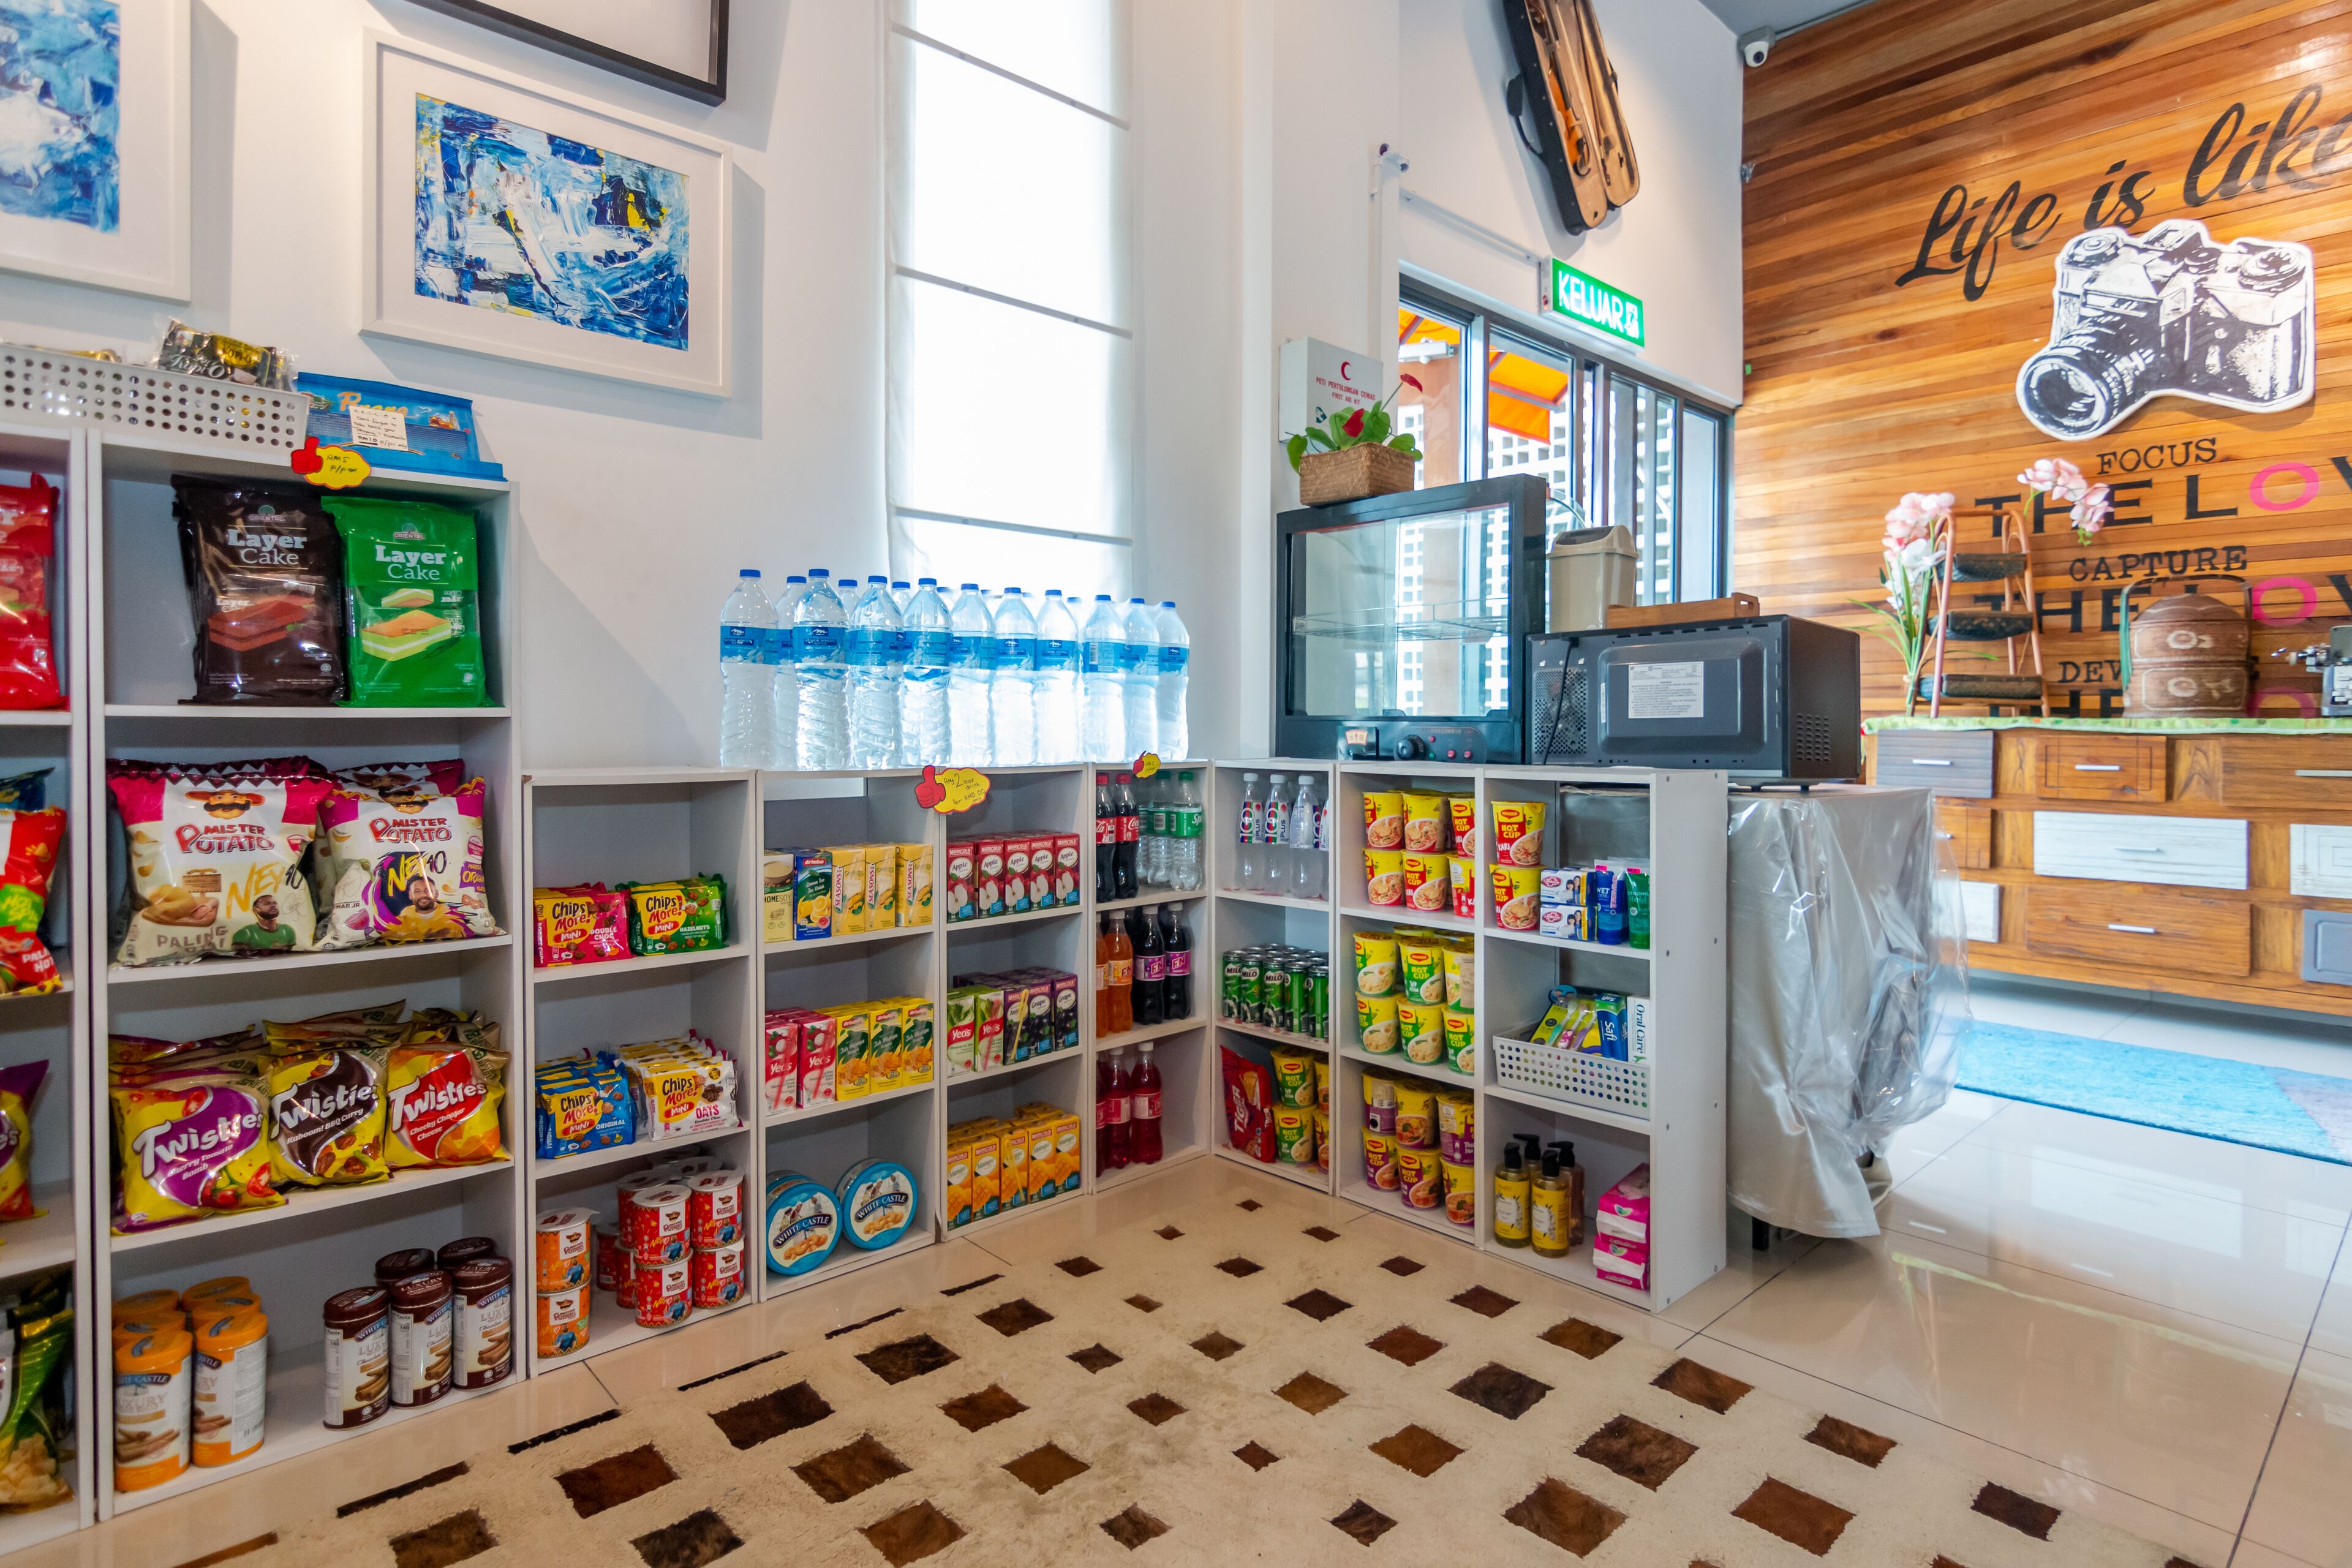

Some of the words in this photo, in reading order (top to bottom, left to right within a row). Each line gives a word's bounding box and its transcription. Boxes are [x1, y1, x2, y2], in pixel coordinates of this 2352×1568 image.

[1894, 180, 2062, 301] Life
[2084, 159, 2156, 231] is
[1558, 270, 1624, 333] KELUAR
[1316, 377, 1326, 386] PETI
[1360, 391, 1376, 401] CEMAS
[1332, 392, 1343, 401] FIRST
[2095, 437, 2218, 475] FOCUS
[227, 529, 307, 552] Layer
[240, 548, 299, 565] Cake
[375, 545, 447, 567] Layer
[2068, 545, 2248, 582] CAPTURE
[388, 564, 440, 581] Cake
[954, 773, 963, 788] 2
[203, 824, 265, 835] MISTER
[368, 818, 452, 844] POTATO
[392, 818, 447, 827] MISTER
[174, 824, 275, 854] POTATO
[983, 859, 998, 869] Apple
[1009, 856, 1025, 866] Apple
[1034, 853, 1049, 864] Apple
[1060, 851, 1074, 861] Apple
[952, 861, 968, 872] Apple
[552, 902, 586, 919] Chips
[646, 895, 677, 913] Chips
[561, 930, 581, 941] MINI
[590, 926, 617, 935] DOUBLE
[655, 922, 674, 933] MINI
[157, 925, 228, 948] PALING
[1031, 998, 1046, 1009] Grape
[1058, 992, 1072, 1002] Grape
[1635, 1004, 1646, 1027] Oral
[952, 1028, 971, 1039] Yeo's
[1635, 1029, 1646, 1054] Care
[662, 1077, 693, 1096] Chips
[389, 1076, 489, 1133] Twisties
[560, 1094, 590, 1112] Chips
[671, 1104, 689, 1116] MINI
[696, 1104, 720, 1119] OATS
[1232, 1085, 1245, 1133] TIGER
[286, 1125, 324, 1145] Kaboom!
[325, 1118, 342, 1131] BBQ
[341, 1107, 364, 1125] Curry
[410, 1120, 437, 1136] Cheeky
[568, 1122, 589, 1134] MINI
[595, 1119, 625, 1129] ORIGINAL
[417, 1126, 443, 1142] Cheese
[132, 1112, 264, 1178] Twisties
[167, 1155, 200, 1177] Cherry
[200, 1144, 233, 1161] Tomato
[1368, 1152, 1383, 1161] HOT
[182, 1163, 209, 1181] Bomb
[858, 1200, 880, 1219] WHITE
[881, 1193, 907, 1205] CASTLE
[776, 1223, 801, 1245] WHITE
[802, 1215, 830, 1228] CASTLE
[480, 1293, 500, 1306] WHITE
[428, 1308, 447, 1324] WHITE
[357, 1321, 380, 1340] WHITE
[135, 1374, 170, 1385] CASTLE
